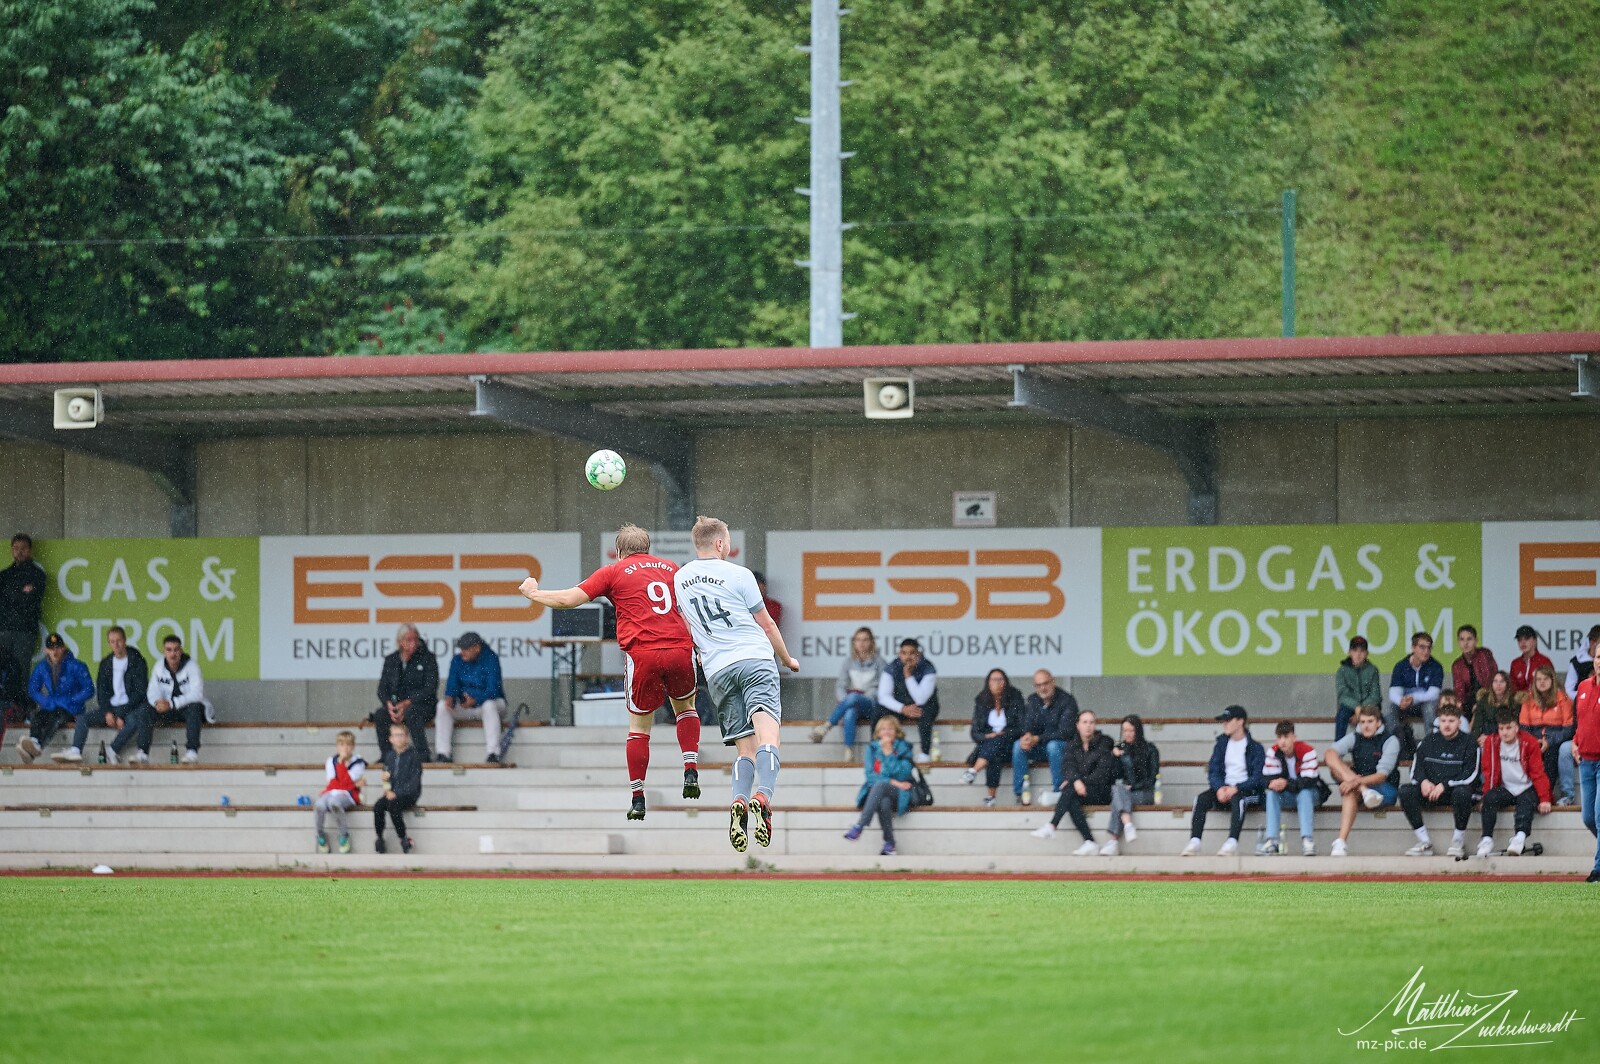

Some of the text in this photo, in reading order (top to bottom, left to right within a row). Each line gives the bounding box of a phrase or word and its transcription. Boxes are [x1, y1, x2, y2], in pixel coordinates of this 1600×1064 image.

[199, 556, 237, 601] &
[293, 553, 546, 624] ESB
[624, 561, 673, 575] SV Laufen
[681, 575, 726, 590] Nußdorf
[802, 549, 1066, 621] ESB
[1126, 543, 1456, 593] ERDGAS &
[646, 581, 672, 615] 9
[689, 595, 733, 636] 14
[35, 617, 235, 662] STROM
[293, 638, 392, 659] ENERGIE
[802, 635, 903, 657] ENEIE
[1126, 600, 1454, 657] ÖKOSTROM
